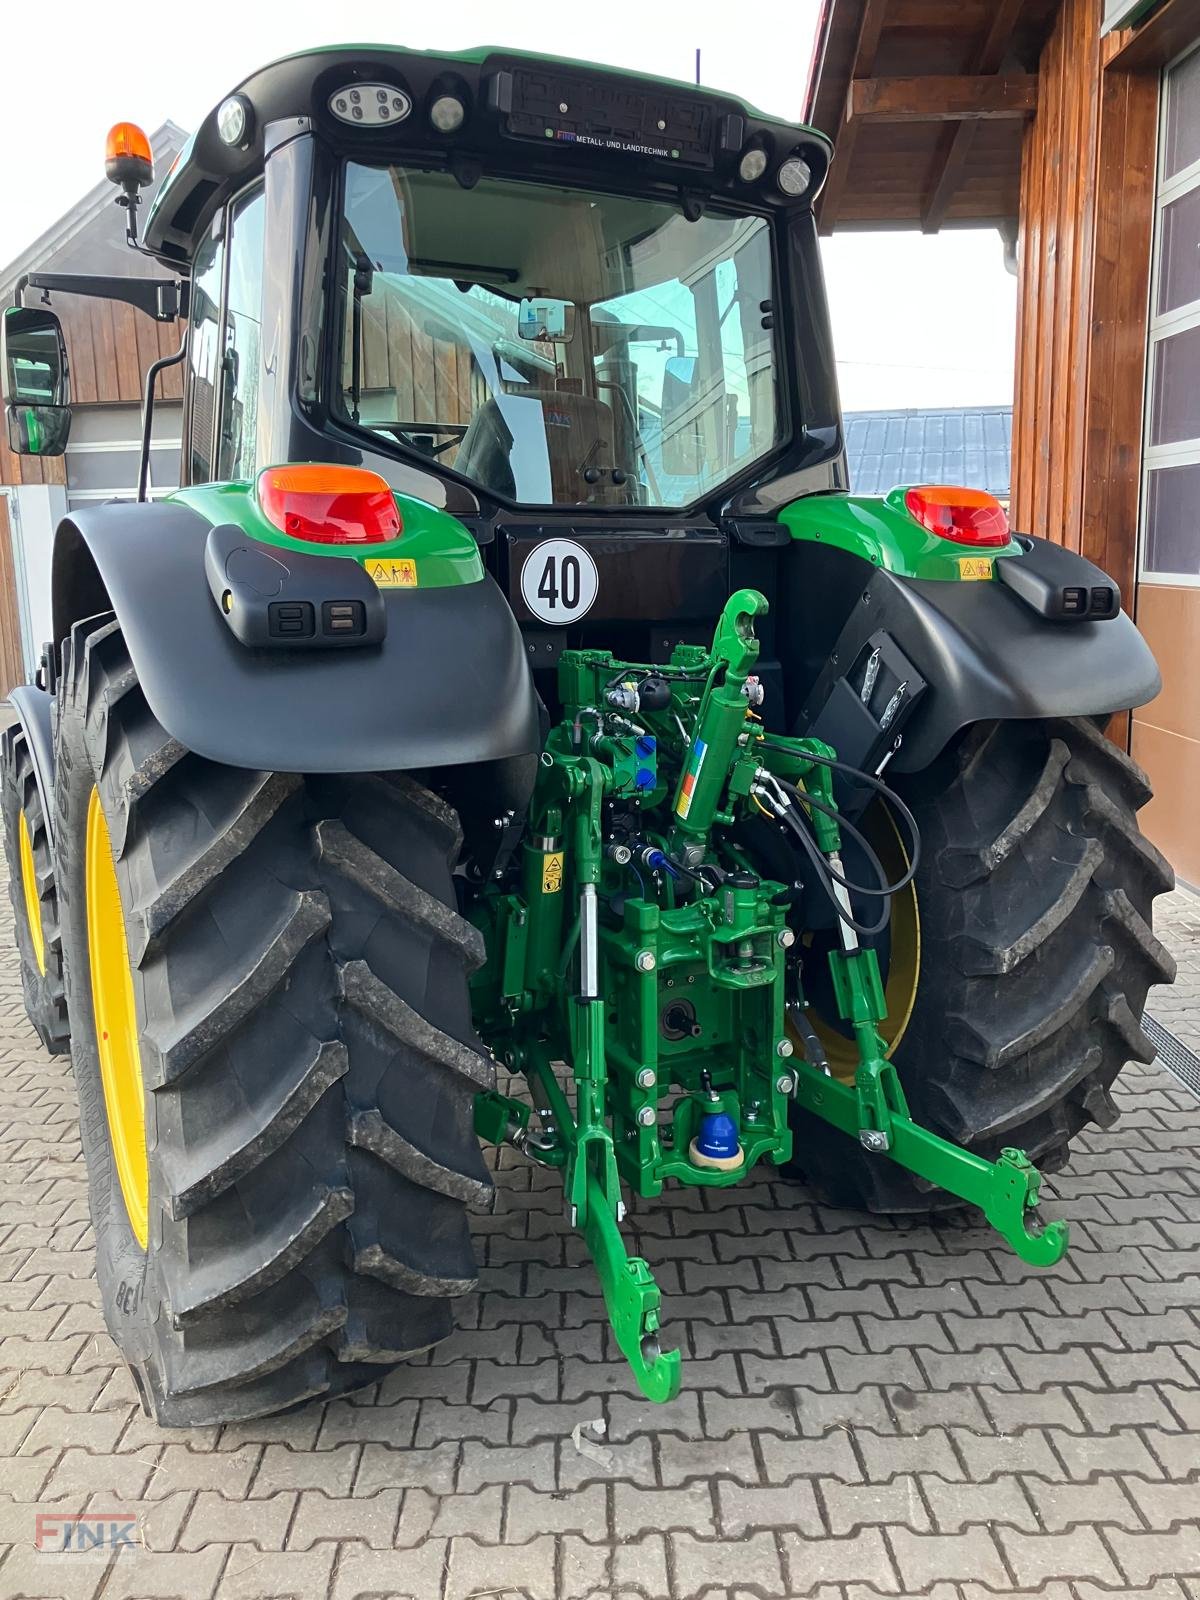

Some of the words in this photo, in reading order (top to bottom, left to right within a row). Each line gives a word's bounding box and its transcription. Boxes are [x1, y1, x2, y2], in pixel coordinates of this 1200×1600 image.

[556, 130, 576, 142] FINK
[576, 135, 605, 147] METALL-
[606, 140, 621, 149] UND
[622, 143, 669, 157] LANDTECHNIK
[537, 555, 581, 609] 40
